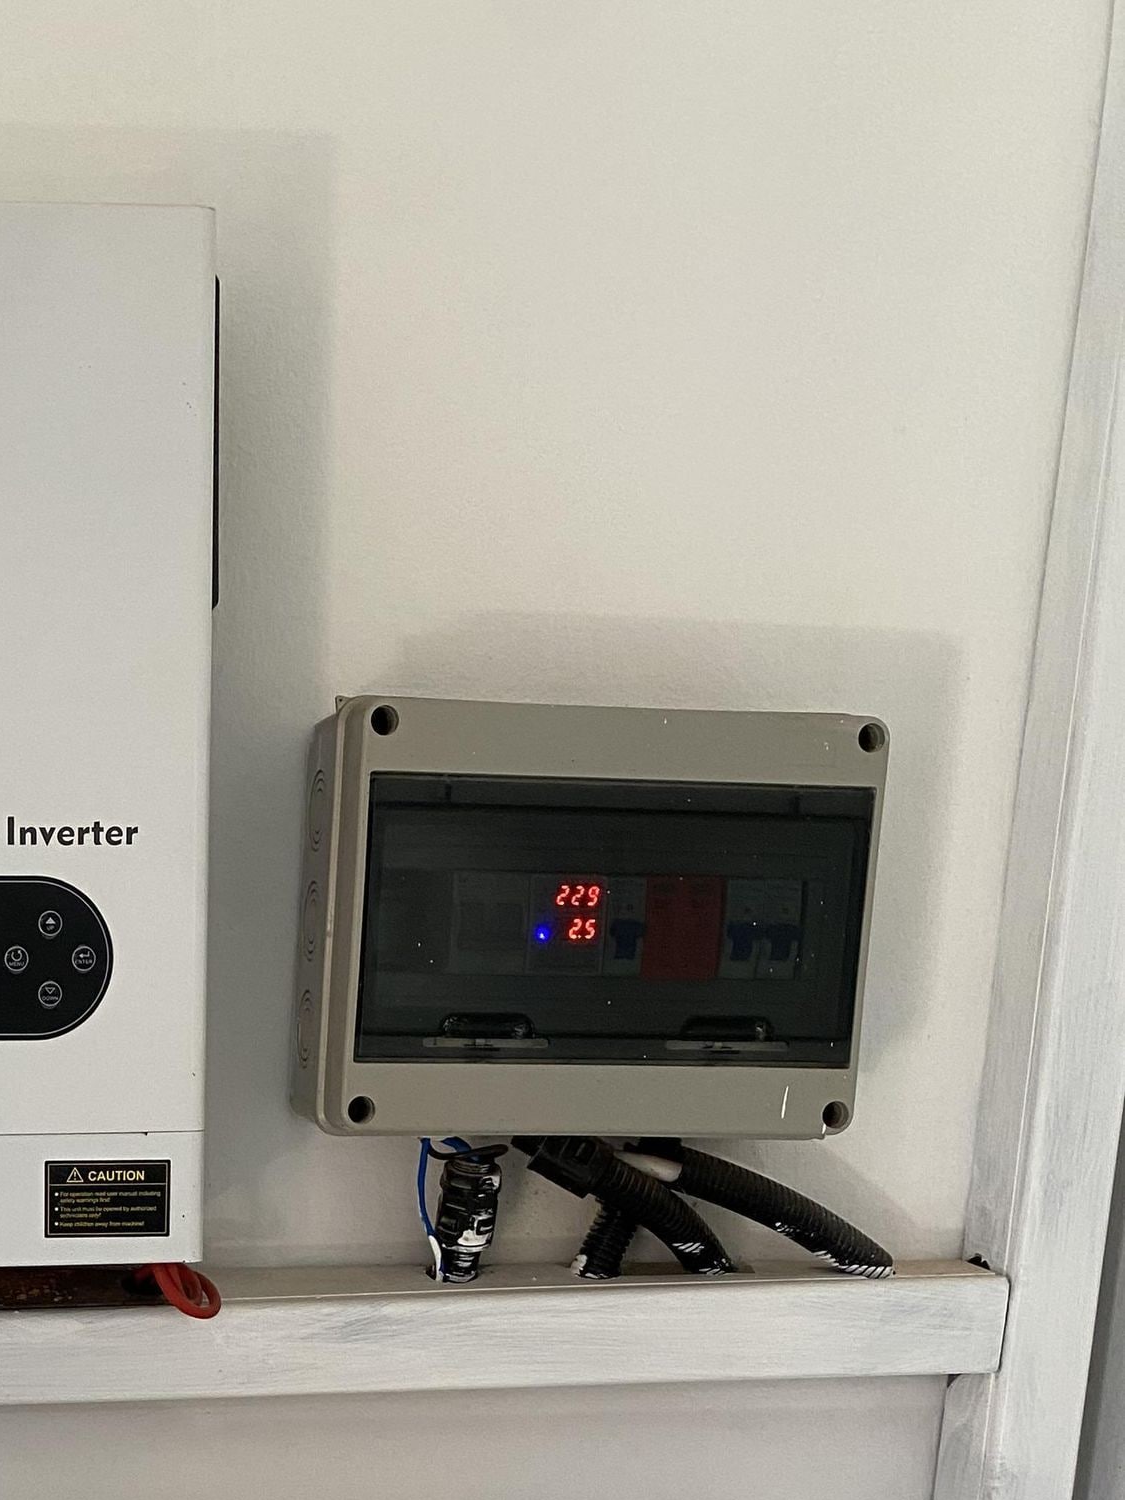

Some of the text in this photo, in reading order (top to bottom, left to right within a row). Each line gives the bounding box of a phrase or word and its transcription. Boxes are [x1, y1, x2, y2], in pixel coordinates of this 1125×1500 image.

[6, 815, 139, 847] Inverter
[556, 885, 601, 906] 229
[568, 918, 596, 940] 2.5
[87, 1170, 145, 1182] CAUTION
